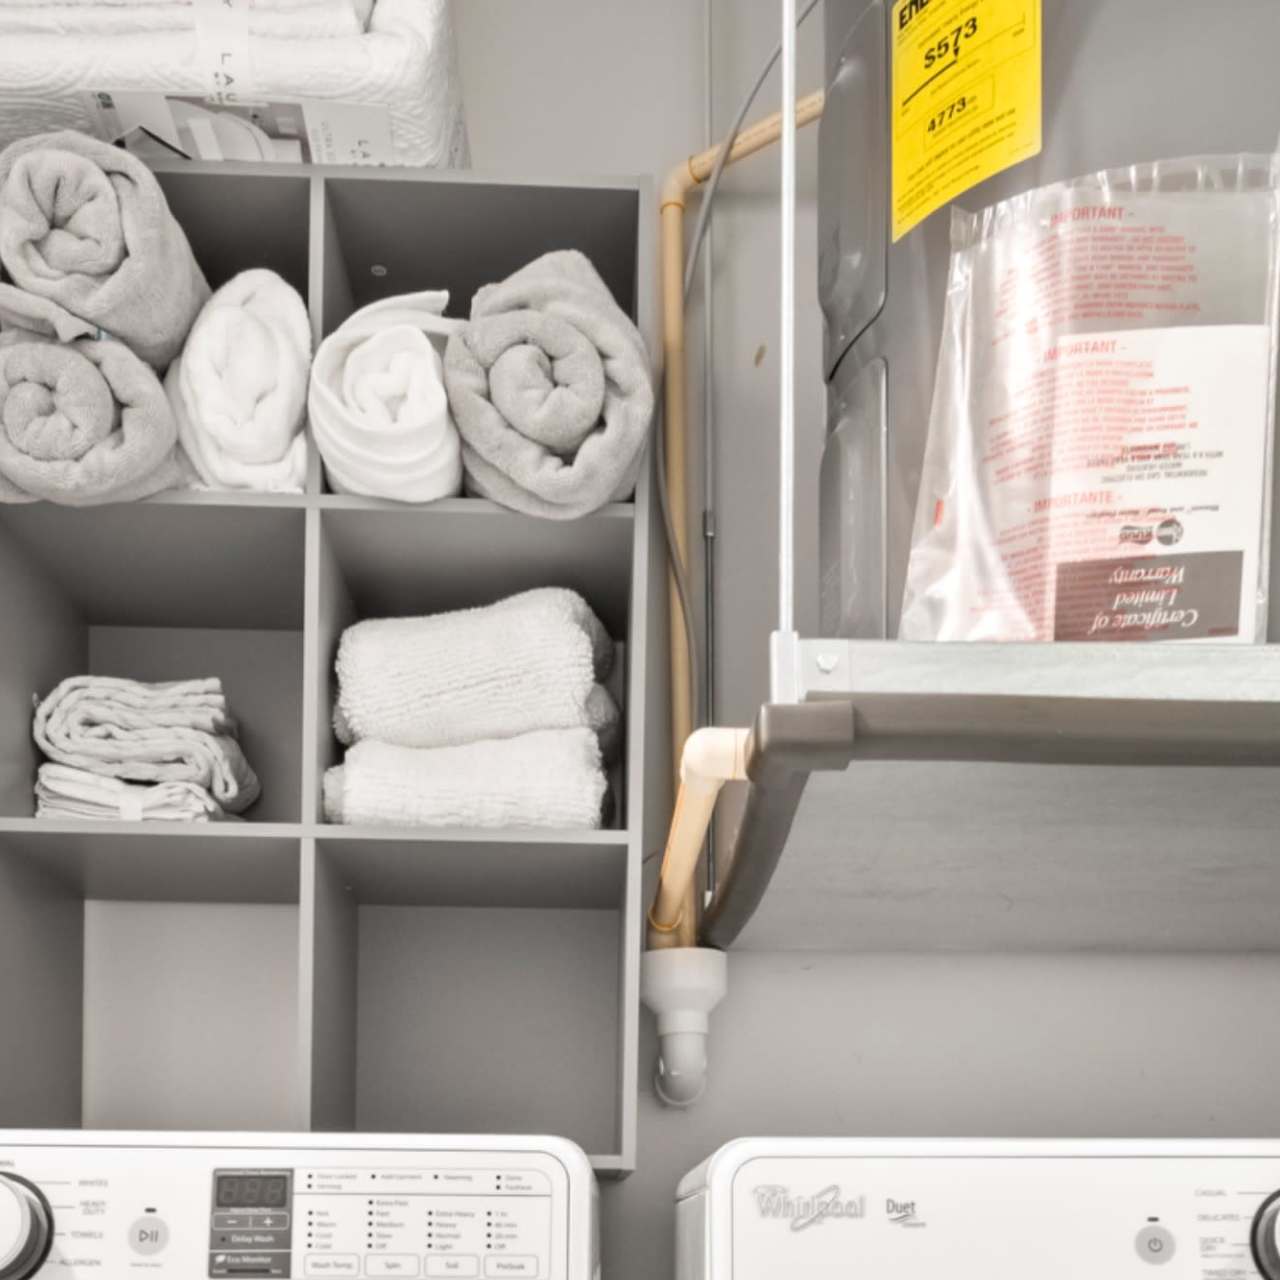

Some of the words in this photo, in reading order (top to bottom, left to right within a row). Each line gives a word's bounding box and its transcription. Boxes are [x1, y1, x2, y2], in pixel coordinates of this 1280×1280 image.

[928, 97, 967, 132] 4773
[1050, 207, 1126, 227] IMPORTANT
[1109, 566, 1184, 584] Warranty
[1113, 589, 1178, 610] Limited
[1088, 612, 1109, 634] of
[1112, 608, 1198, 629] Certificate
[752, 1184, 866, 1232] Whirlpool
[886, 1198, 916, 1214] Duet
[231, 1235, 253, 1243] Delay
